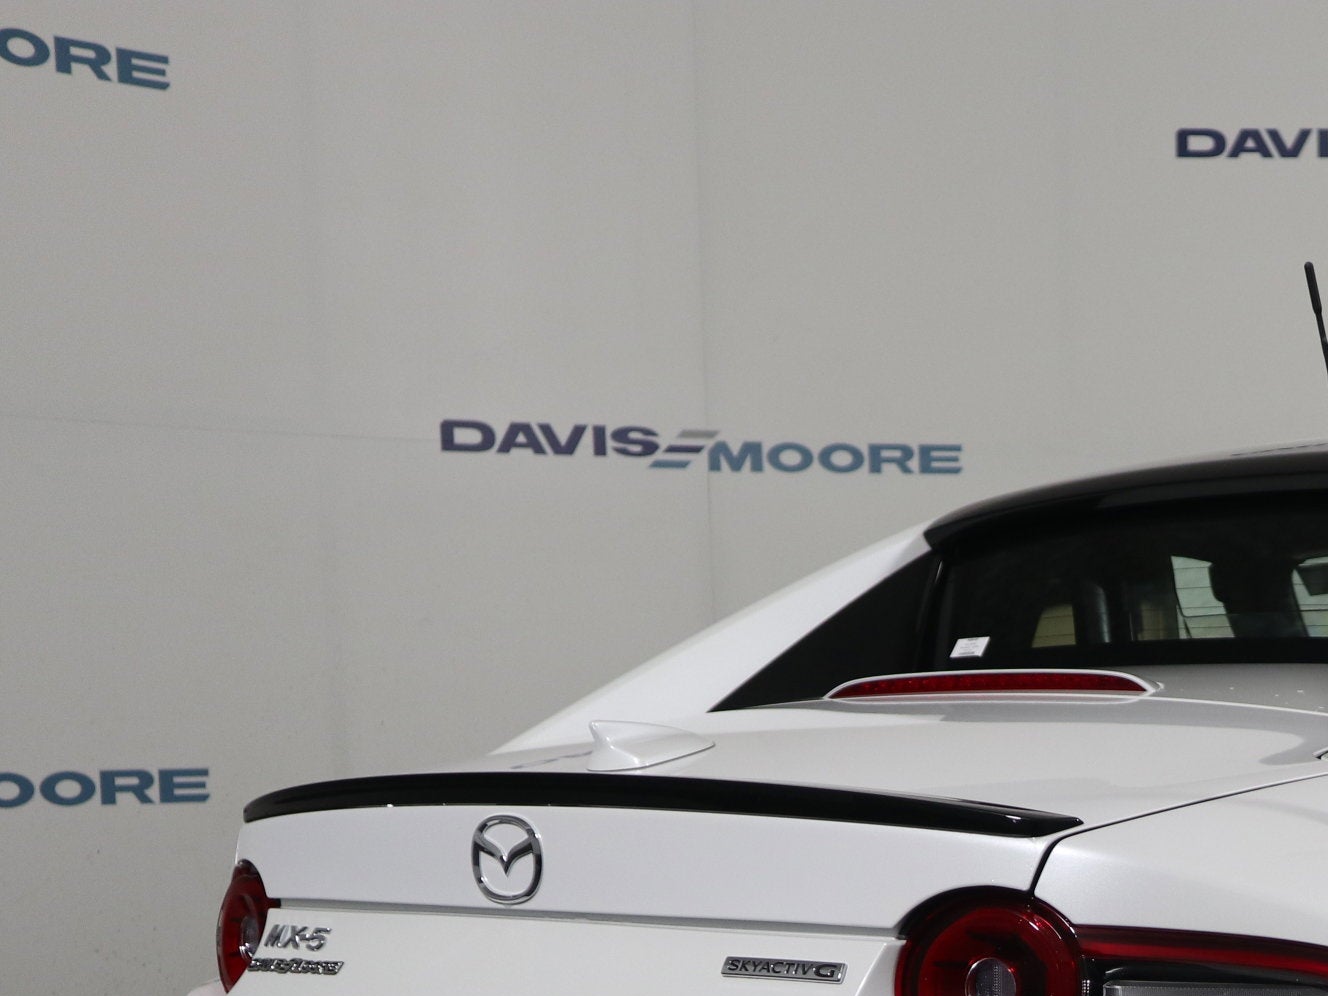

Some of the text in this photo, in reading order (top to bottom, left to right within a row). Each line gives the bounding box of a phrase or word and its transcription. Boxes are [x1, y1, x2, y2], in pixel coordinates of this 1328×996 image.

[0, 28, 170, 90] ORE
[440, 419, 963, 474] DAVIS MOORE
[264, 924, 332, 951] MX-5
